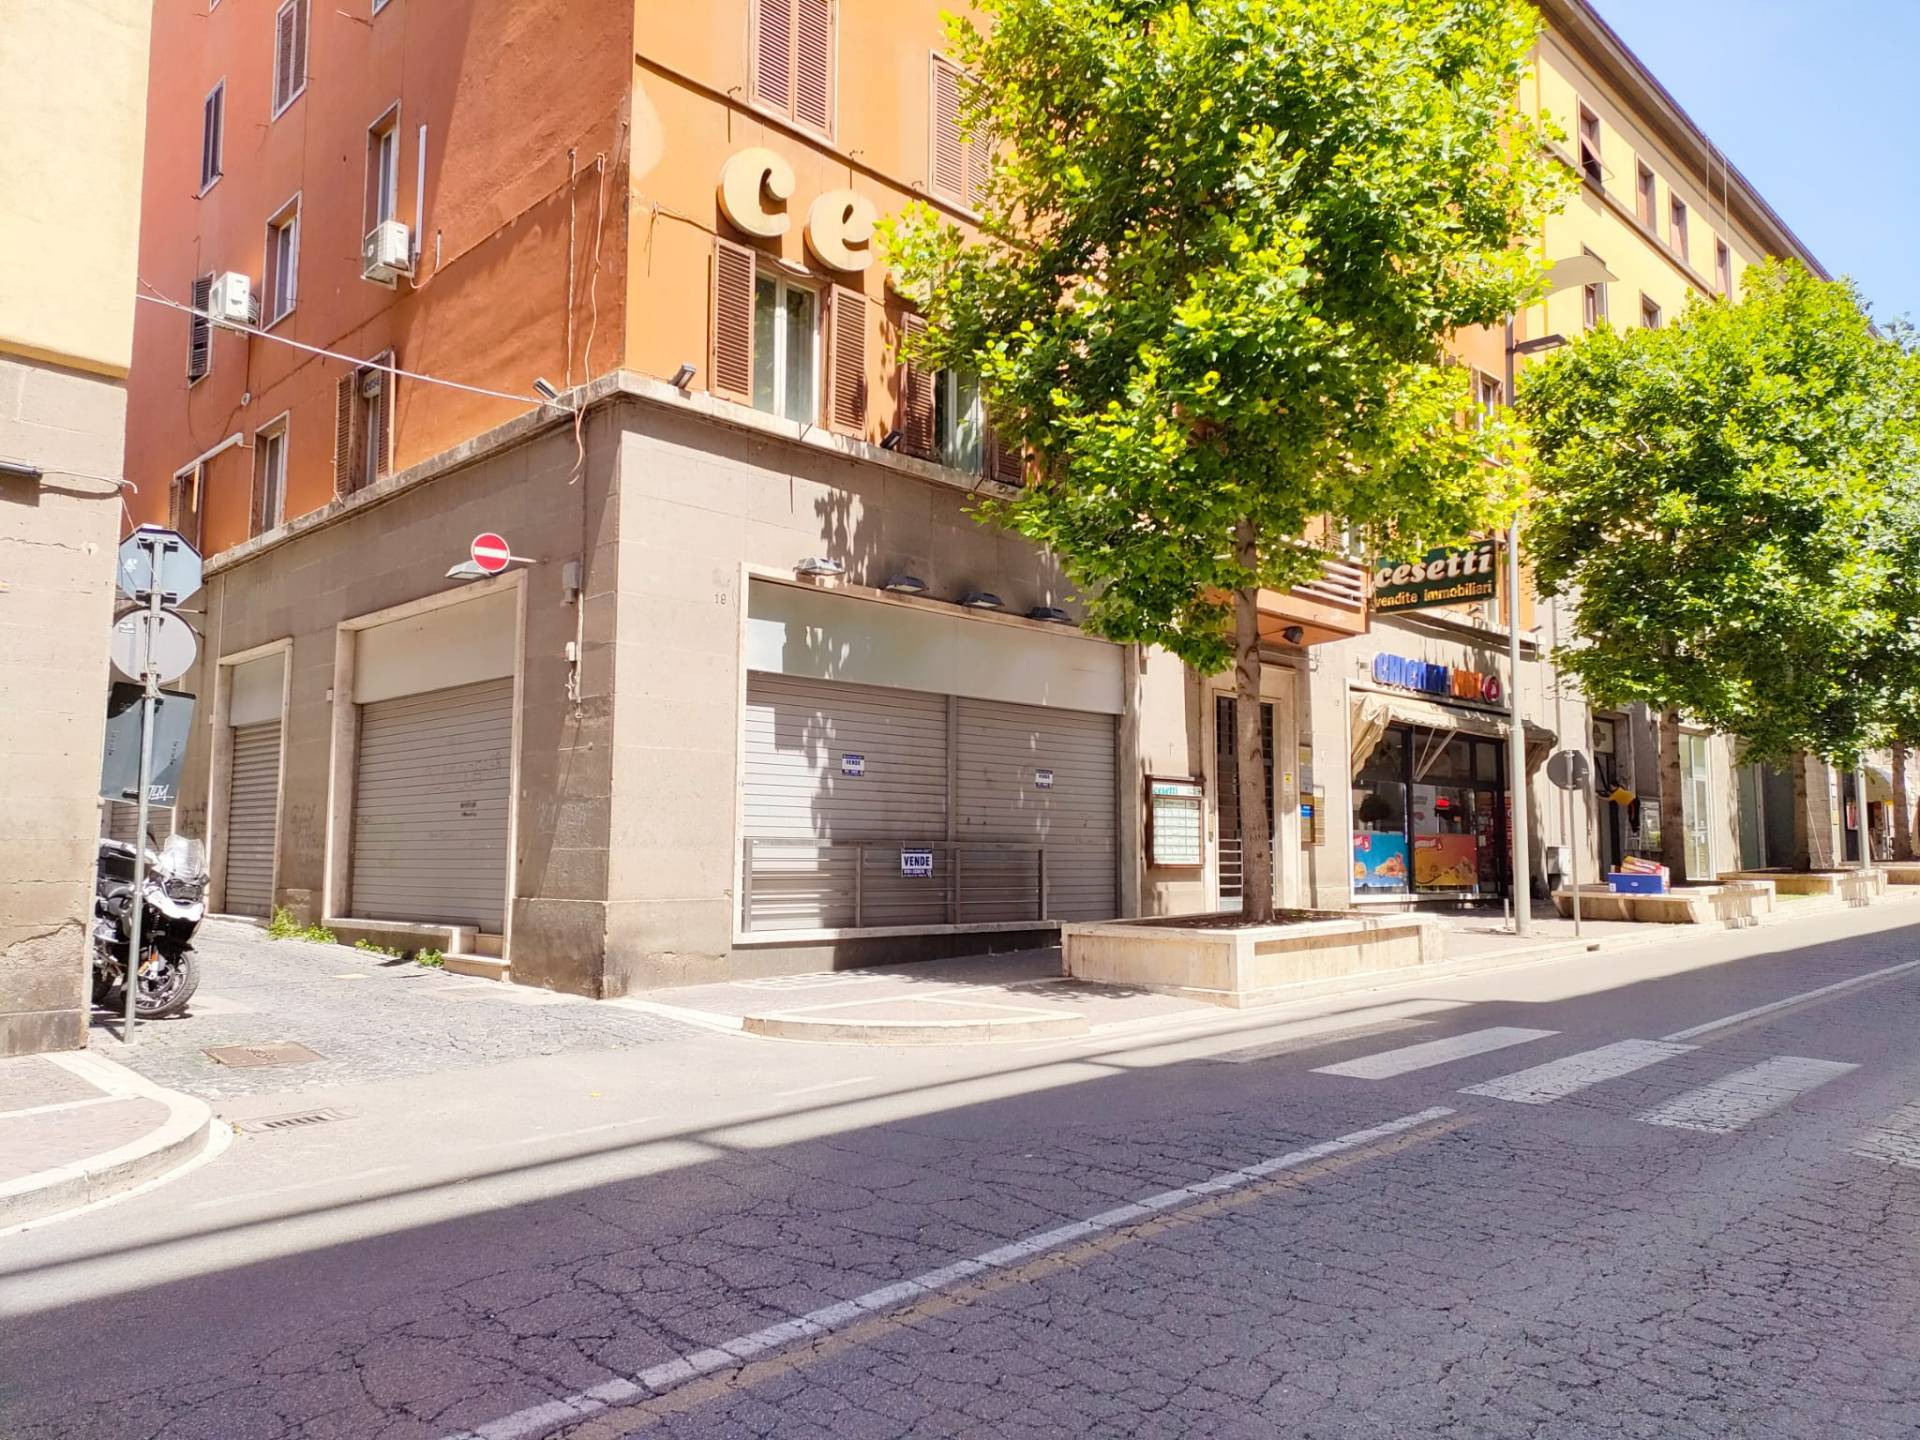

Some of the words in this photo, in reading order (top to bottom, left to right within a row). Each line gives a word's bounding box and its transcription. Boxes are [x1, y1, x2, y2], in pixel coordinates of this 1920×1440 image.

[718, 147, 925, 295] ce
[1375, 545, 1492, 588] cesetti
[1375, 591, 1419, 608] vendite
[1423, 580, 1492, 602] immobiliari
[903, 855, 930, 867] VENDE
